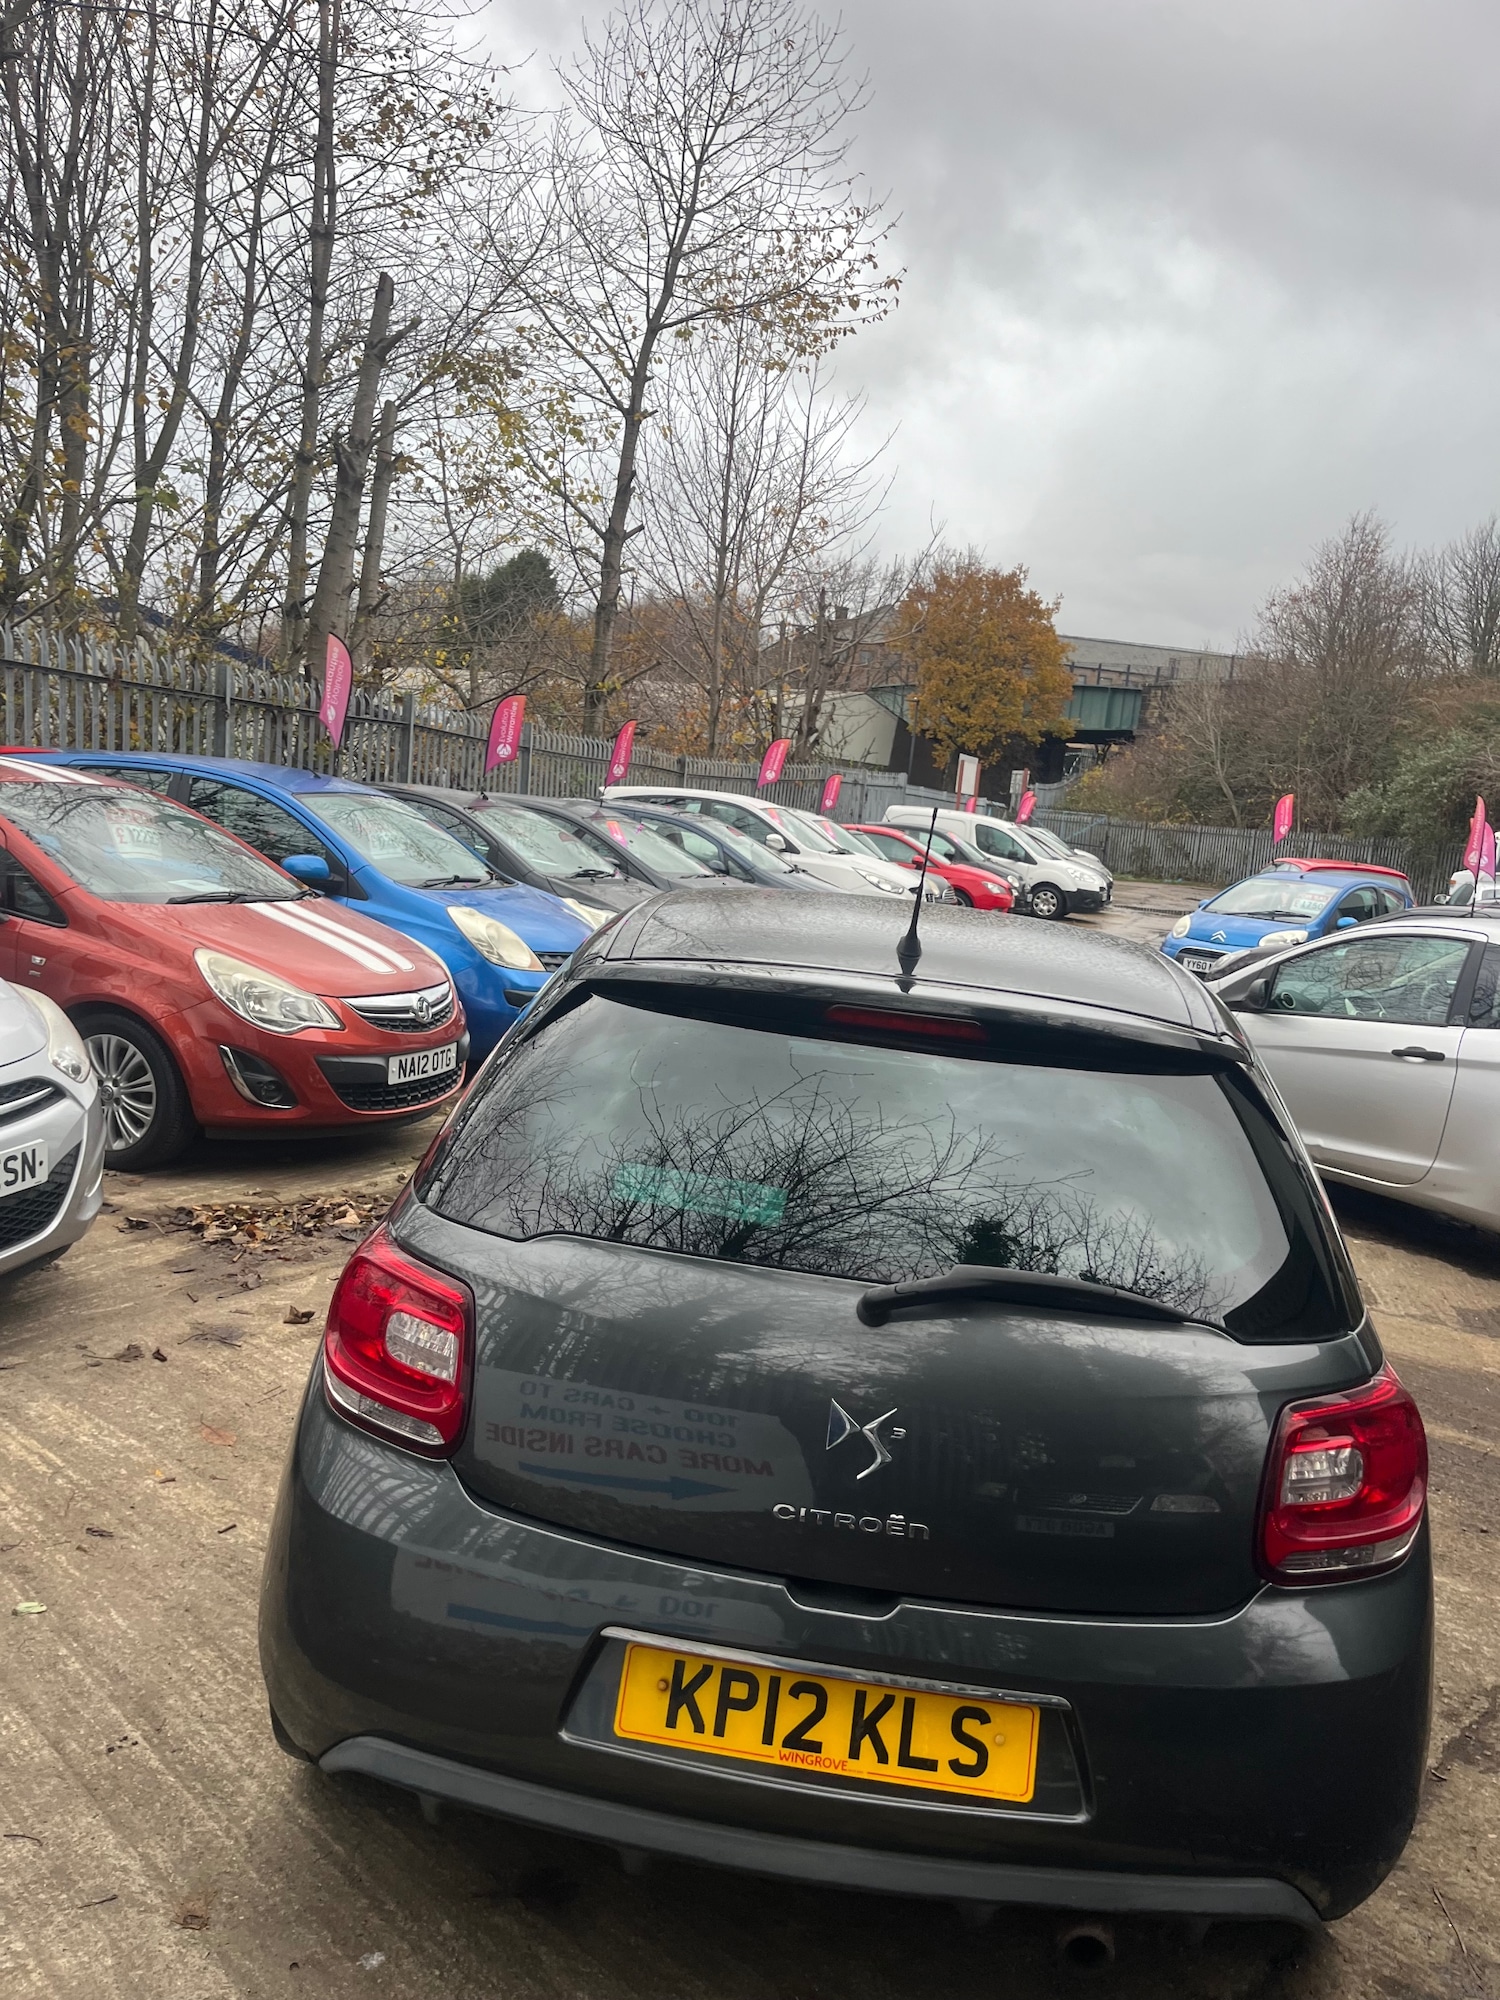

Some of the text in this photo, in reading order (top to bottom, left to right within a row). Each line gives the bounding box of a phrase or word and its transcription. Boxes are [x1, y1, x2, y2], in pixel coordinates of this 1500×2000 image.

[499, 708, 509, 742] Evolution
[506, 701, 518, 743] Warranties
[1187, 959, 1207, 970] YY60
[398, 1048, 452, 1079] NA12 OTG
[0, 1149, 36, 1188] SN
[665, 1659, 992, 1778] KP12 KLS
[778, 1749, 848, 1772] WINGROVE
